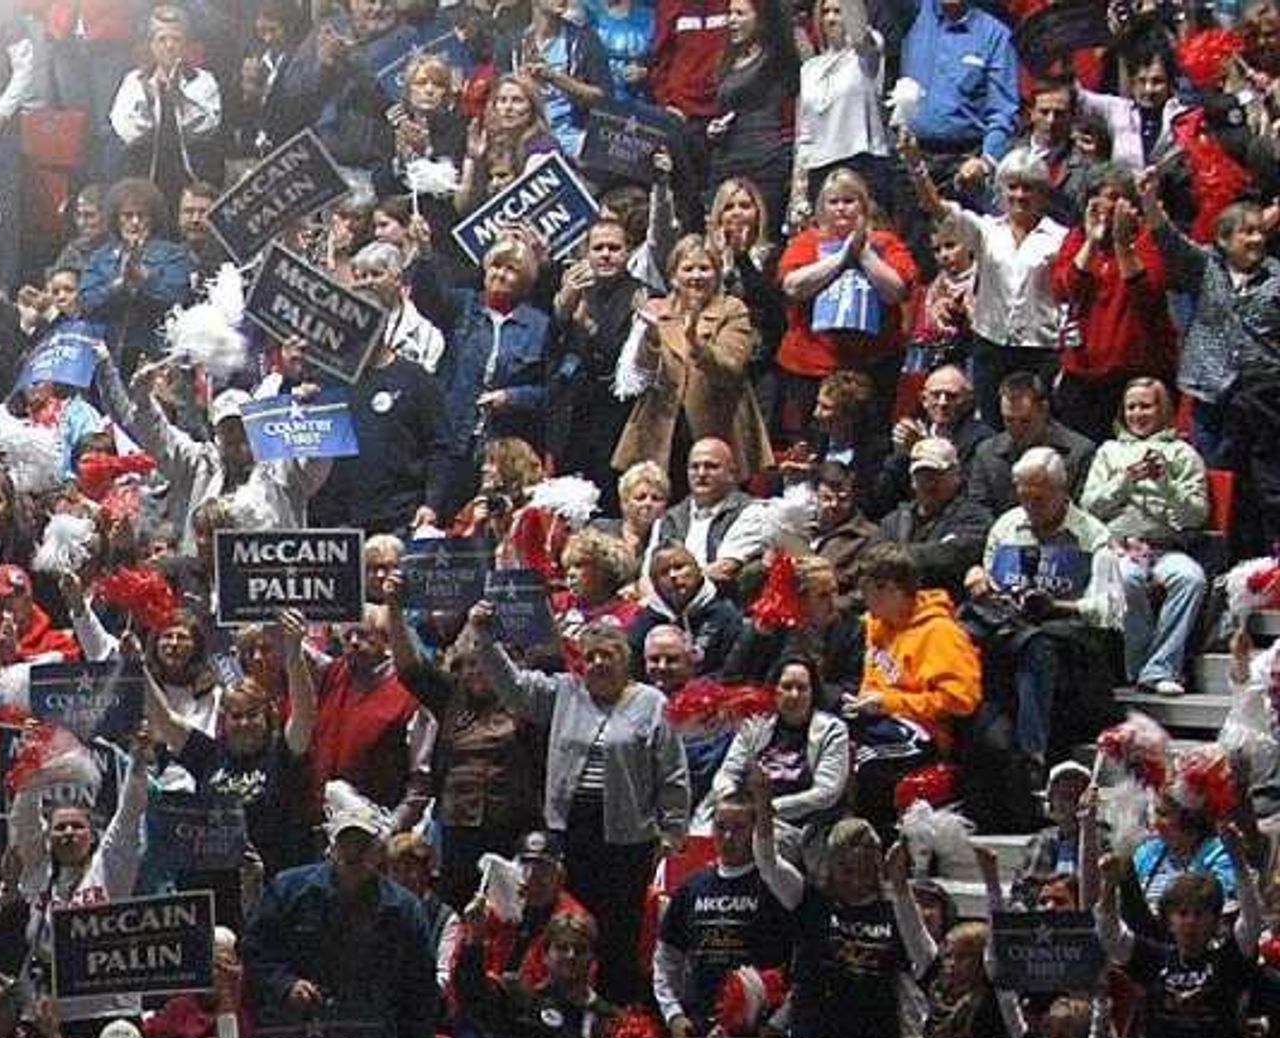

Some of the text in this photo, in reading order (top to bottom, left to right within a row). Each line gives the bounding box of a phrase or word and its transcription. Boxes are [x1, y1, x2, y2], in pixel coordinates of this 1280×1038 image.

[223, 144, 309, 222] McCAIN
[247, 176, 316, 236] PALIN
[472, 166, 562, 248] McCAIN
[274, 257, 373, 328] McCAIN
[272, 294, 344, 351] PALIN
[262, 419, 335, 438] COUNTRY
[232, 539, 348, 566] McCAIN
[247, 578, 335, 602] PALIN
[68, 902, 198, 939] McCAIN
[694, 896, 759, 912] McCAIN
[86, 943, 183, 976] PALIN
